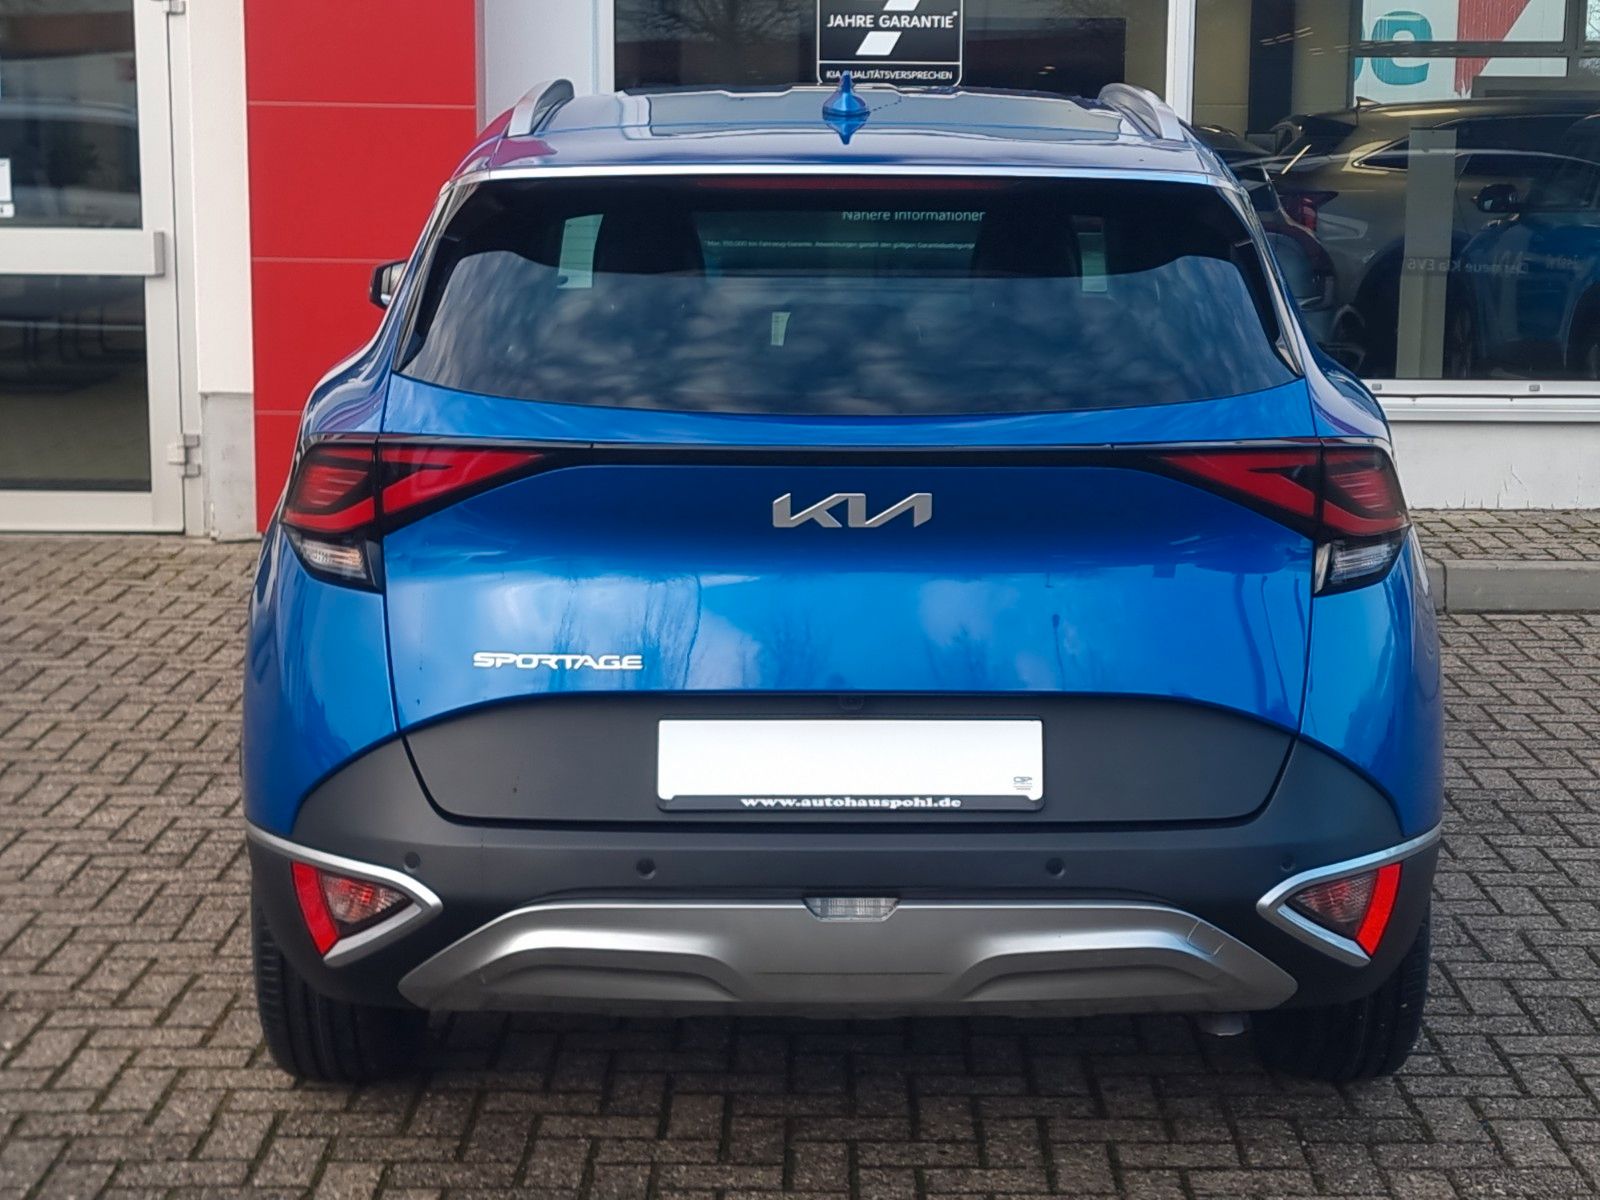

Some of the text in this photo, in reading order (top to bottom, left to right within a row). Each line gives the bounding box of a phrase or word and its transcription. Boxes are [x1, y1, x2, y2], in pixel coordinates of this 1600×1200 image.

[827, 14, 874, 27] JAHRE
[826, 69, 953, 80] KIA UALITÄTSVERSPRECHEN
[473, 652, 643, 670] SPORTAGE
[740, 797, 962, 809] www.autohauspohl.de
